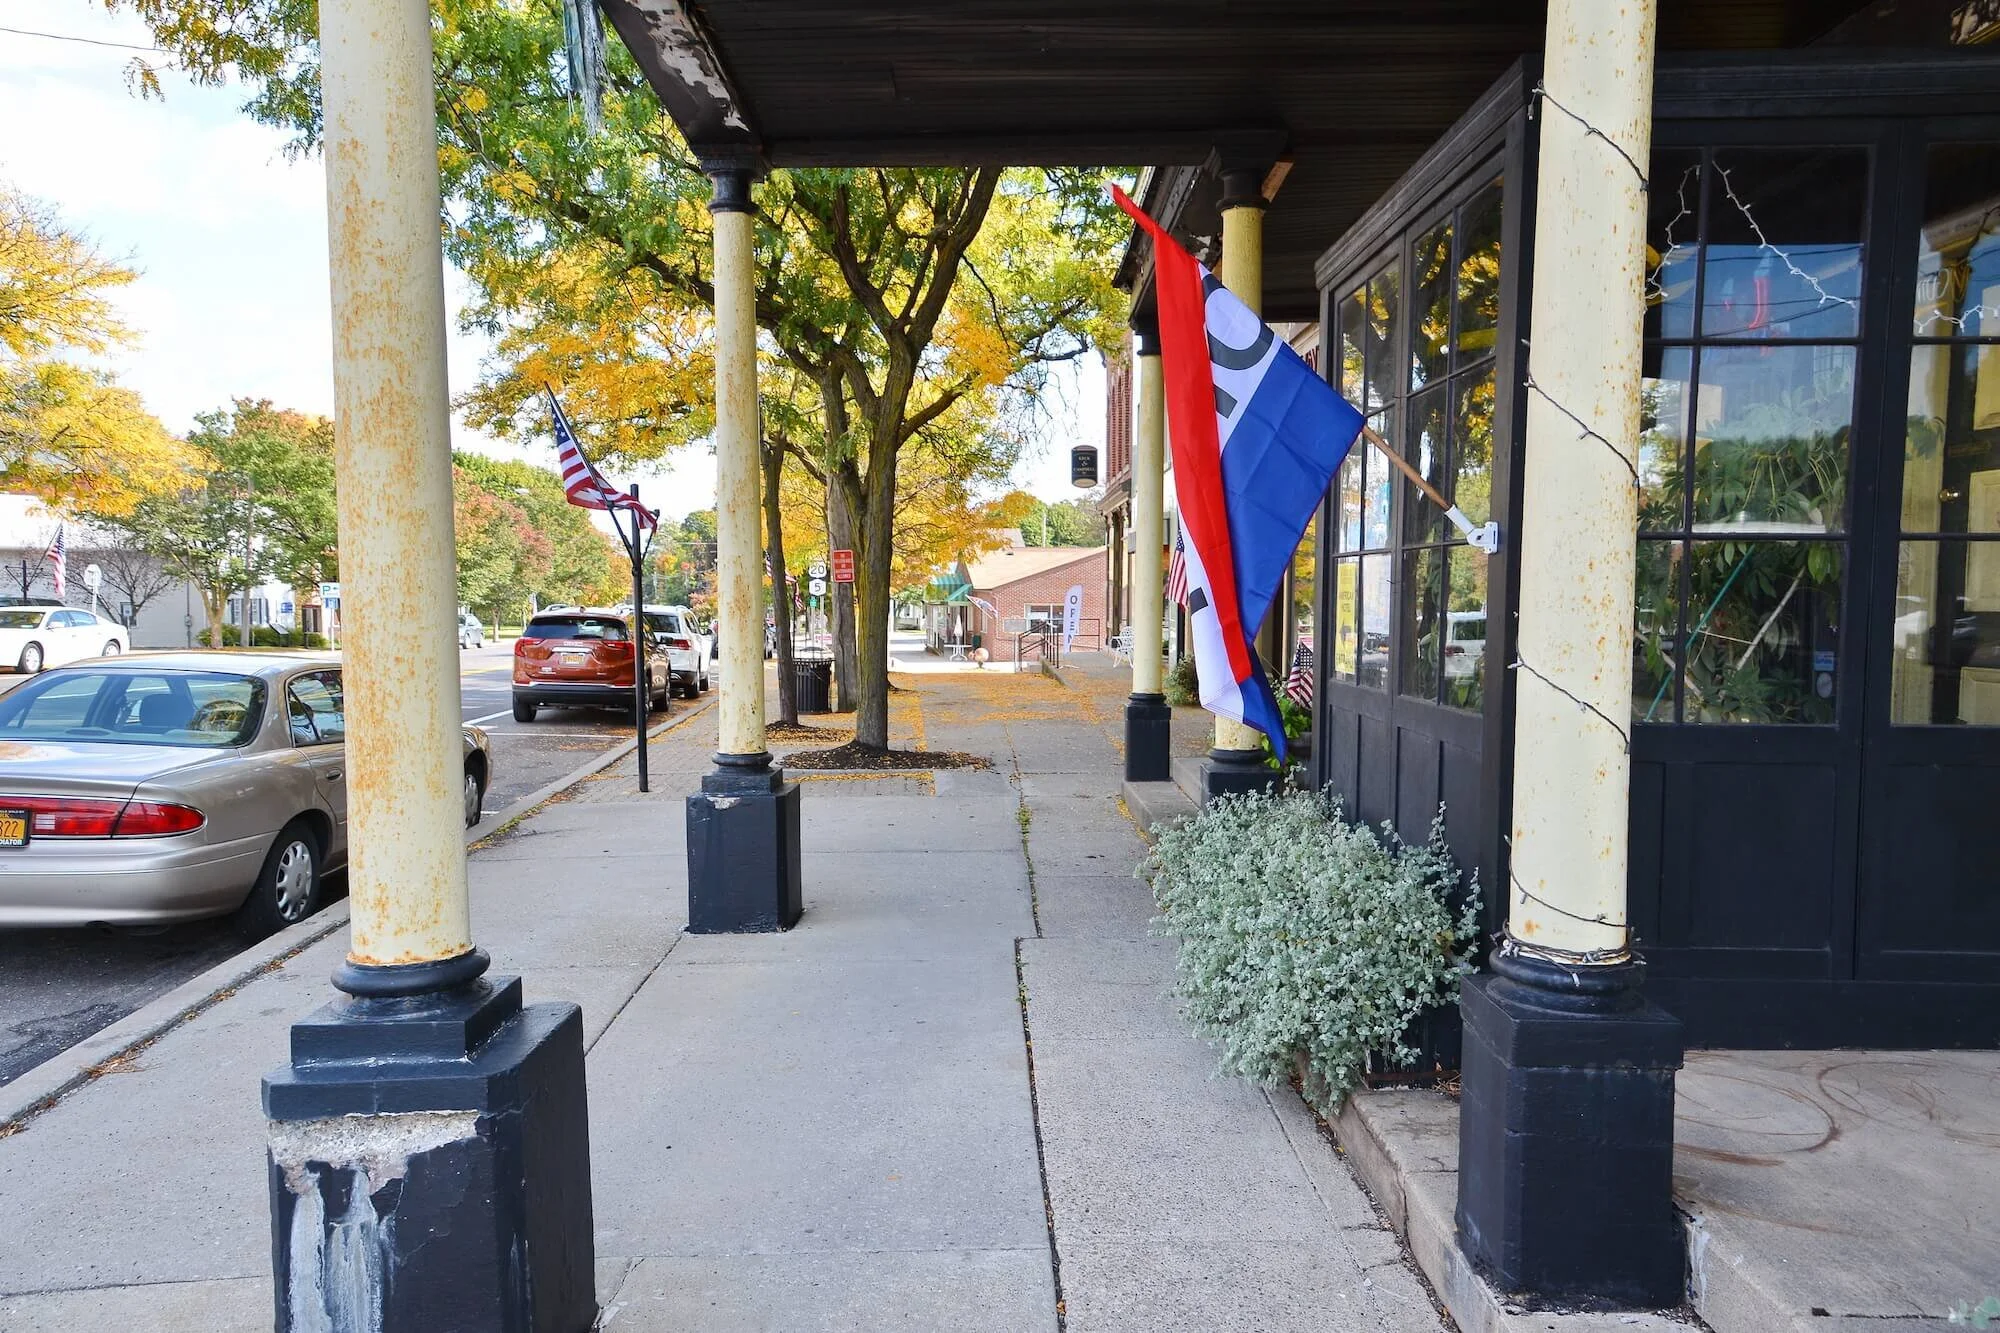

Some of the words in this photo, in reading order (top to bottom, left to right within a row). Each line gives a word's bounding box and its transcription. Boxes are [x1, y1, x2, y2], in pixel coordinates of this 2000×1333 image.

[810, 564, 825, 575] 20
[322, 585, 331, 596] P
[814, 582, 821, 592] 5
